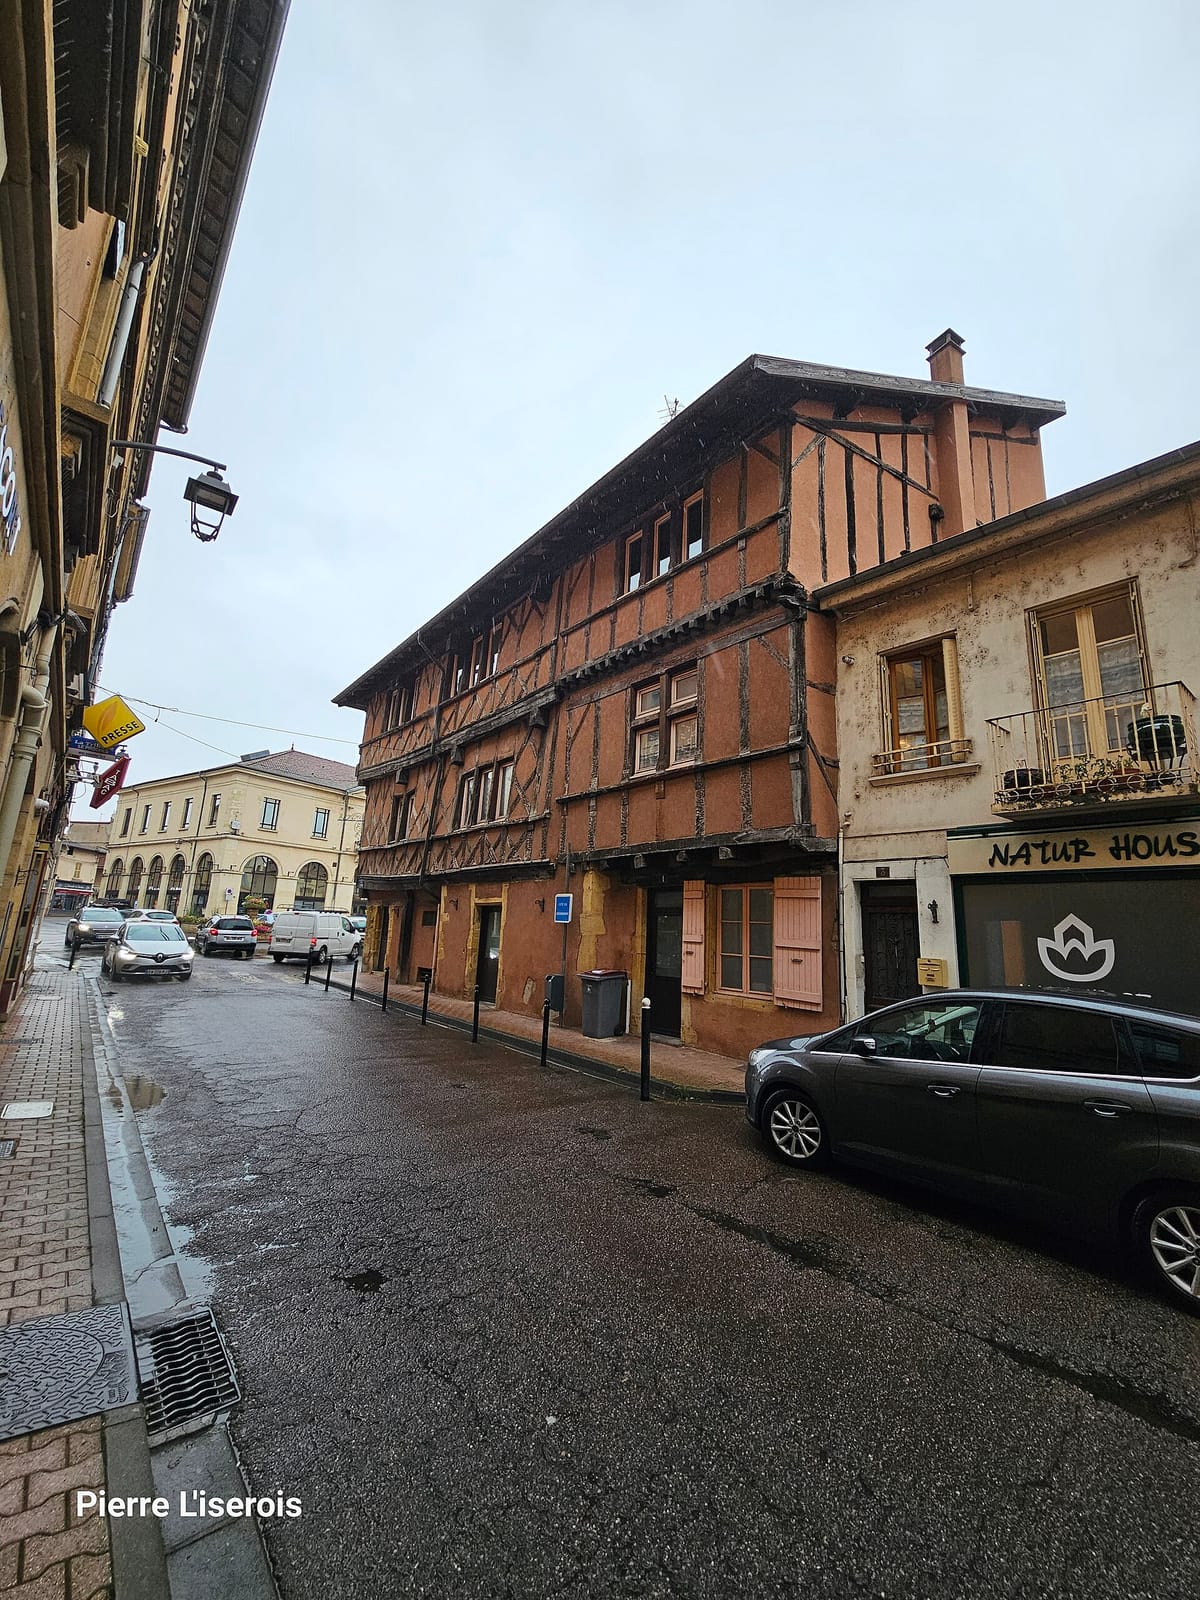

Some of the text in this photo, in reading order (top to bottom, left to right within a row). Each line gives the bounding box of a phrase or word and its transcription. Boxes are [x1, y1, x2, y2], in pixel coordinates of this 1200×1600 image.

[101, 721, 139, 744] PRESSE
[101, 769, 120, 795] TABAC
[989, 832, 1200, 867] NATUR HOUS
